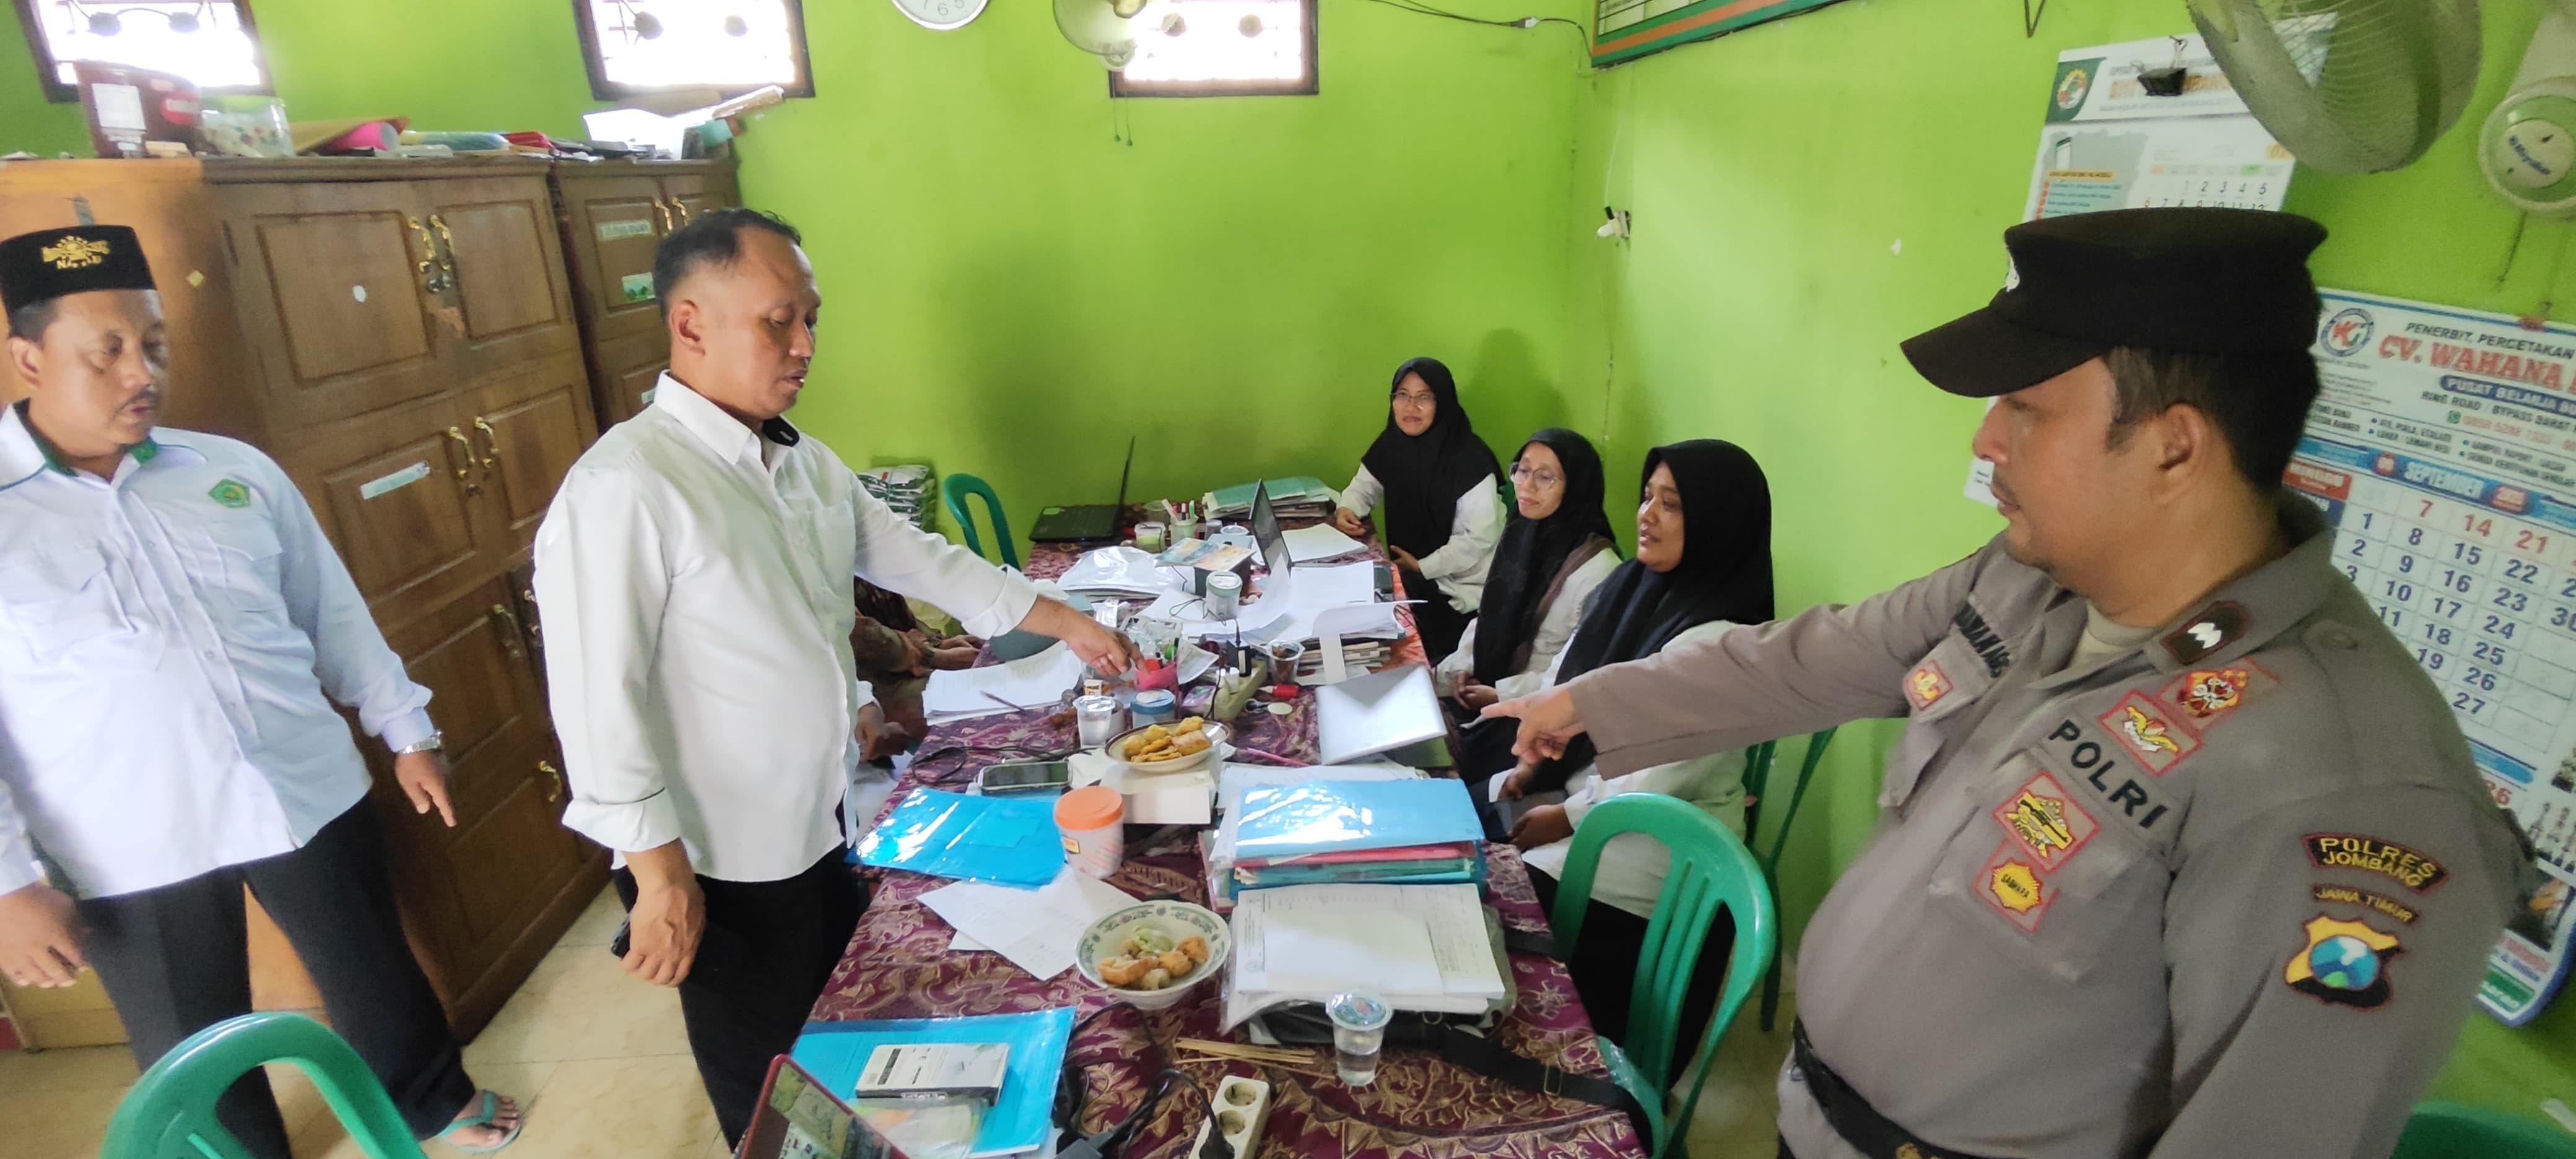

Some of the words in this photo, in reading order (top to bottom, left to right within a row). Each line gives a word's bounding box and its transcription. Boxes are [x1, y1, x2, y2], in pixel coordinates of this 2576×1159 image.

[938, 3, 949, 16] 6
[2201, 181, 2209, 192] 2
[2219, 181, 2227, 193] 3
[2239, 183, 2247, 193] 4
[2259, 183, 2267, 195] 5
[2378, 334, 2422, 363] CV.
[2430, 342, 2564, 391] WAHANA
[2478, 334, 2575, 359] PERCETAKAN
[2446, 377, 2492, 395] PUSAT
[2495, 386, 2557, 409] BELANJA
[2452, 396, 2481, 410] ROAD
[2492, 404, 2533, 422] BYPASS
[2535, 414, 2570, 430] BARAT
[2403, 461, 2485, 498] SEPTEMBER
[2421, 499, 2434, 518] 7
[2465, 514, 2492, 537] 14
[2515, 530, 2549, 554] 21
[2362, 513, 2373, 529] 1
[2408, 527, 2423, 545] 8
[2455, 542, 2482, 565] 15
[2506, 559, 2538, 584] 22
[2351, 539, 2366, 557] 2
[2400, 555, 2414, 573] 9
[2444, 570, 2472, 593] 16
[2493, 588, 2528, 612] 23
[2346, 565, 2358, 583] 3
[2387, 580, 2412, 602] 10
[2434, 597, 2462, 619] 17
[2483, 615, 2516, 640] 24
[2379, 606, 2402, 627] 11
[2425, 623, 2452, 645] 18
[2473, 641, 2505, 666] 25
[2417, 648, 2444, 670] 19
[2463, 667, 2497, 691] 26
[2453, 692, 2486, 714] 27
[2048, 719, 2168, 829] POLRI
[2320, 837, 2437, 878] POLRES
[2323, 851, 2425, 887] JOMBANG
[2316, 888, 2361, 903] JAWA
[2365, 895, 2413, 922] TIMUR
